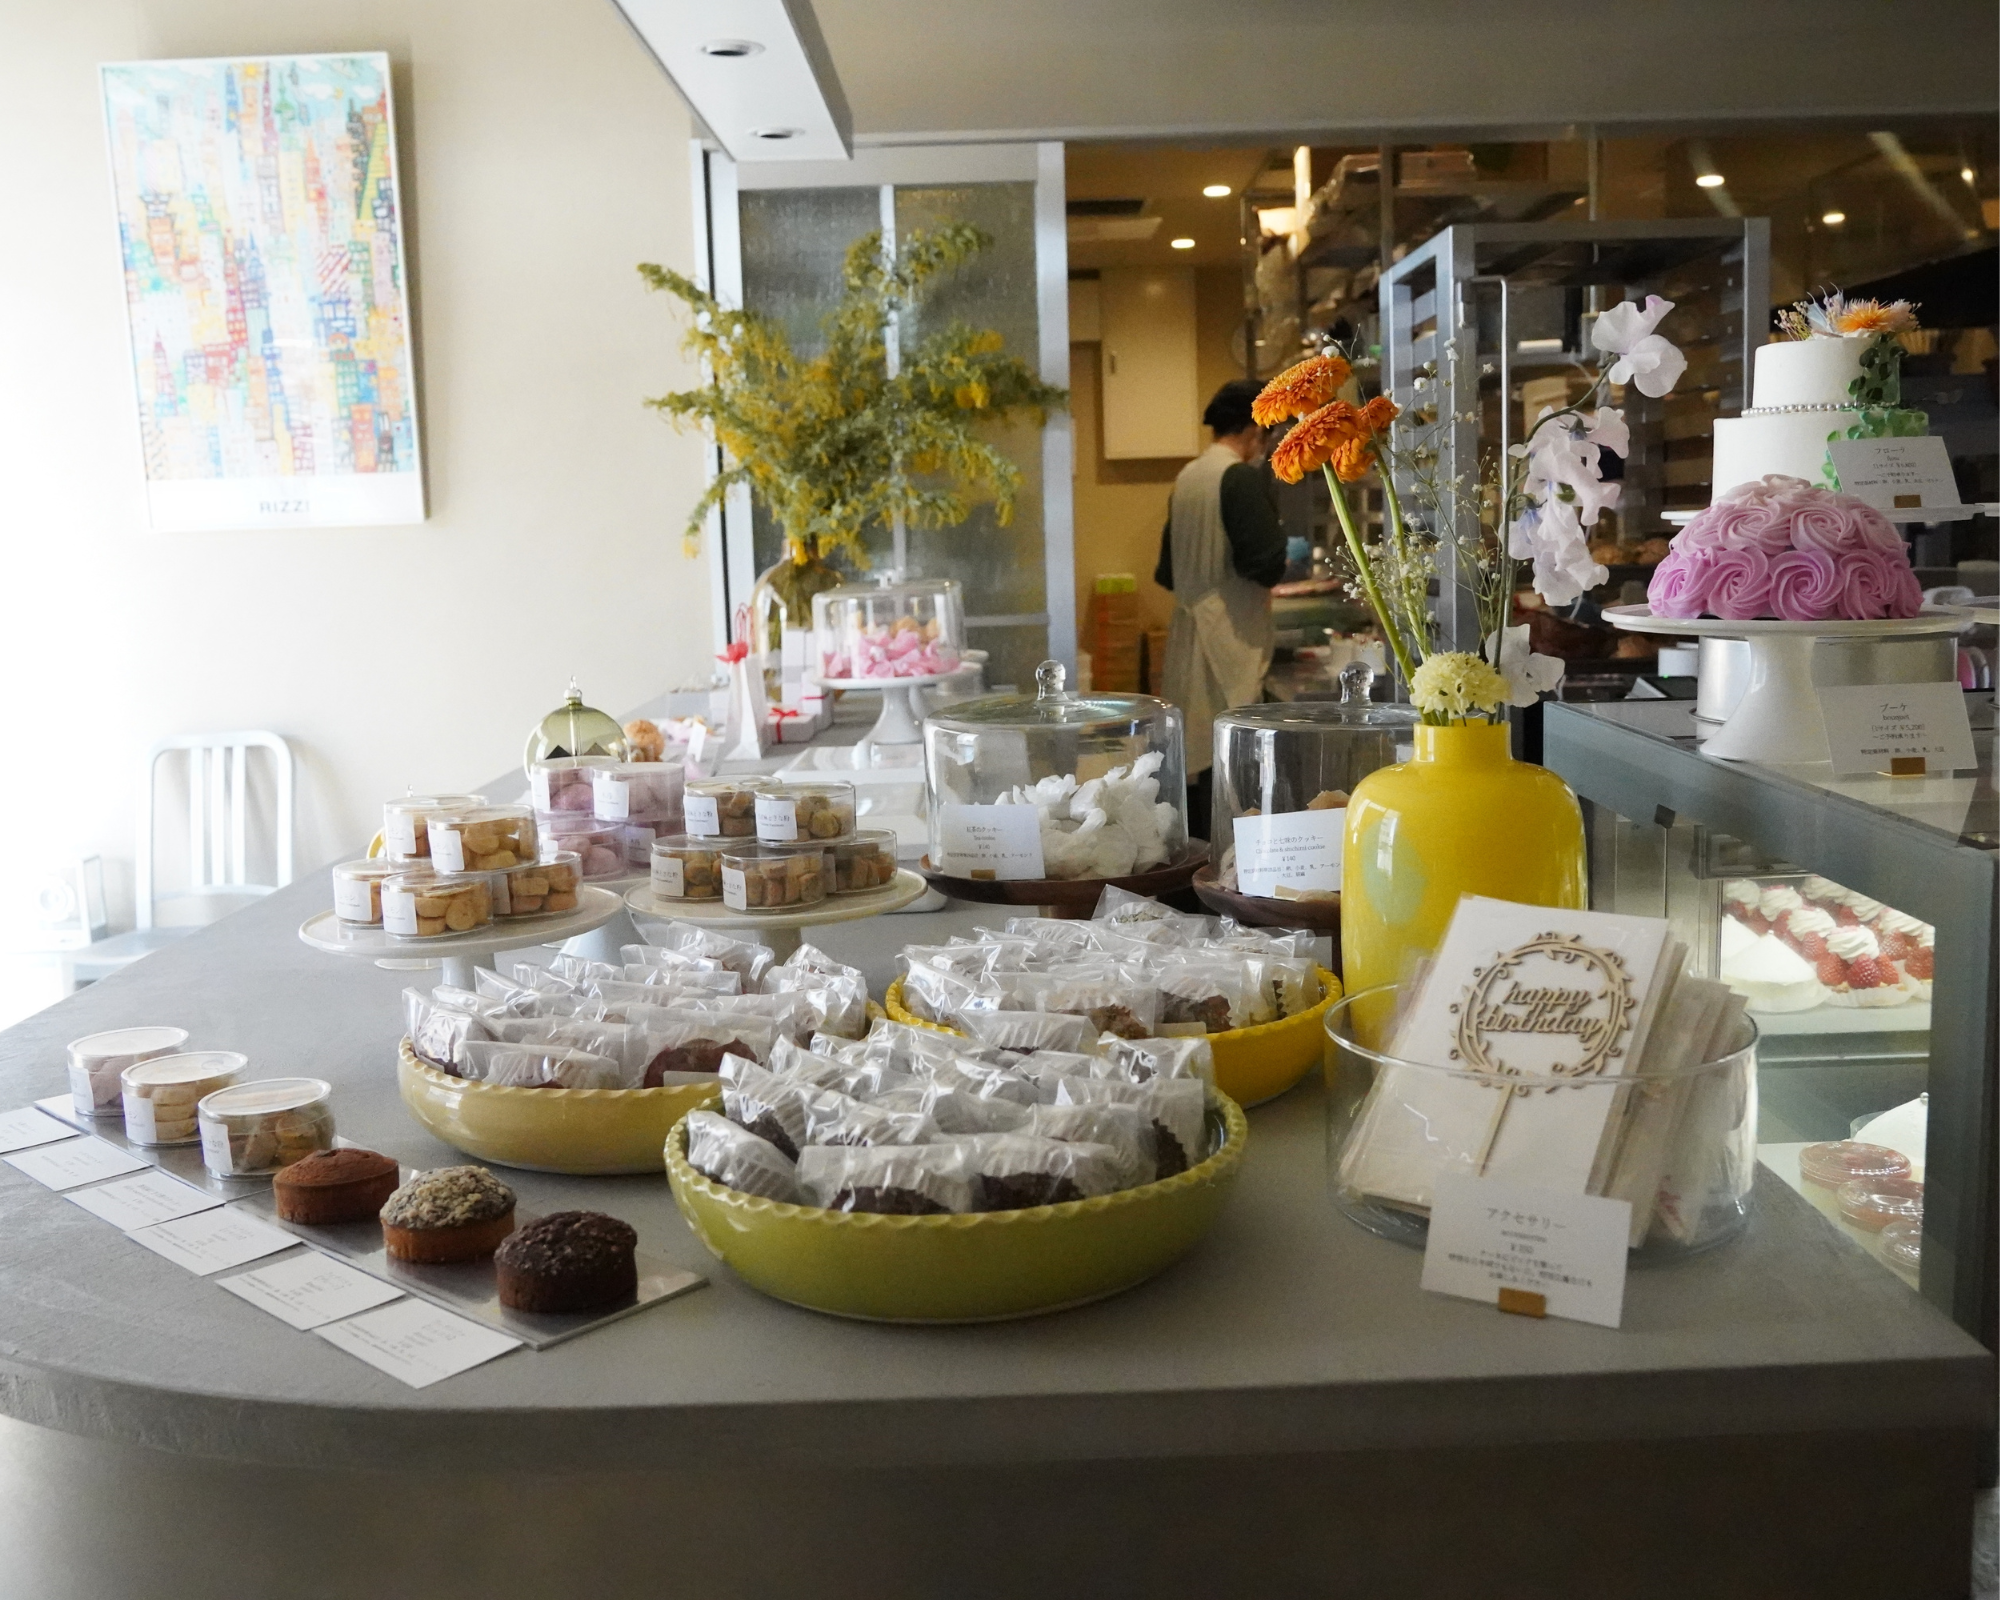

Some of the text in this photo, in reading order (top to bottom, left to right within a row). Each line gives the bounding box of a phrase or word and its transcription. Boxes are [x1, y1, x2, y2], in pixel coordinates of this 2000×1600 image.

[259, 499, 310, 514] RIZZI
[1502, 981, 1592, 1014] happy
[1477, 1002, 1603, 1043] birthday
[1486, 1207, 1567, 1230] アクセサリー
